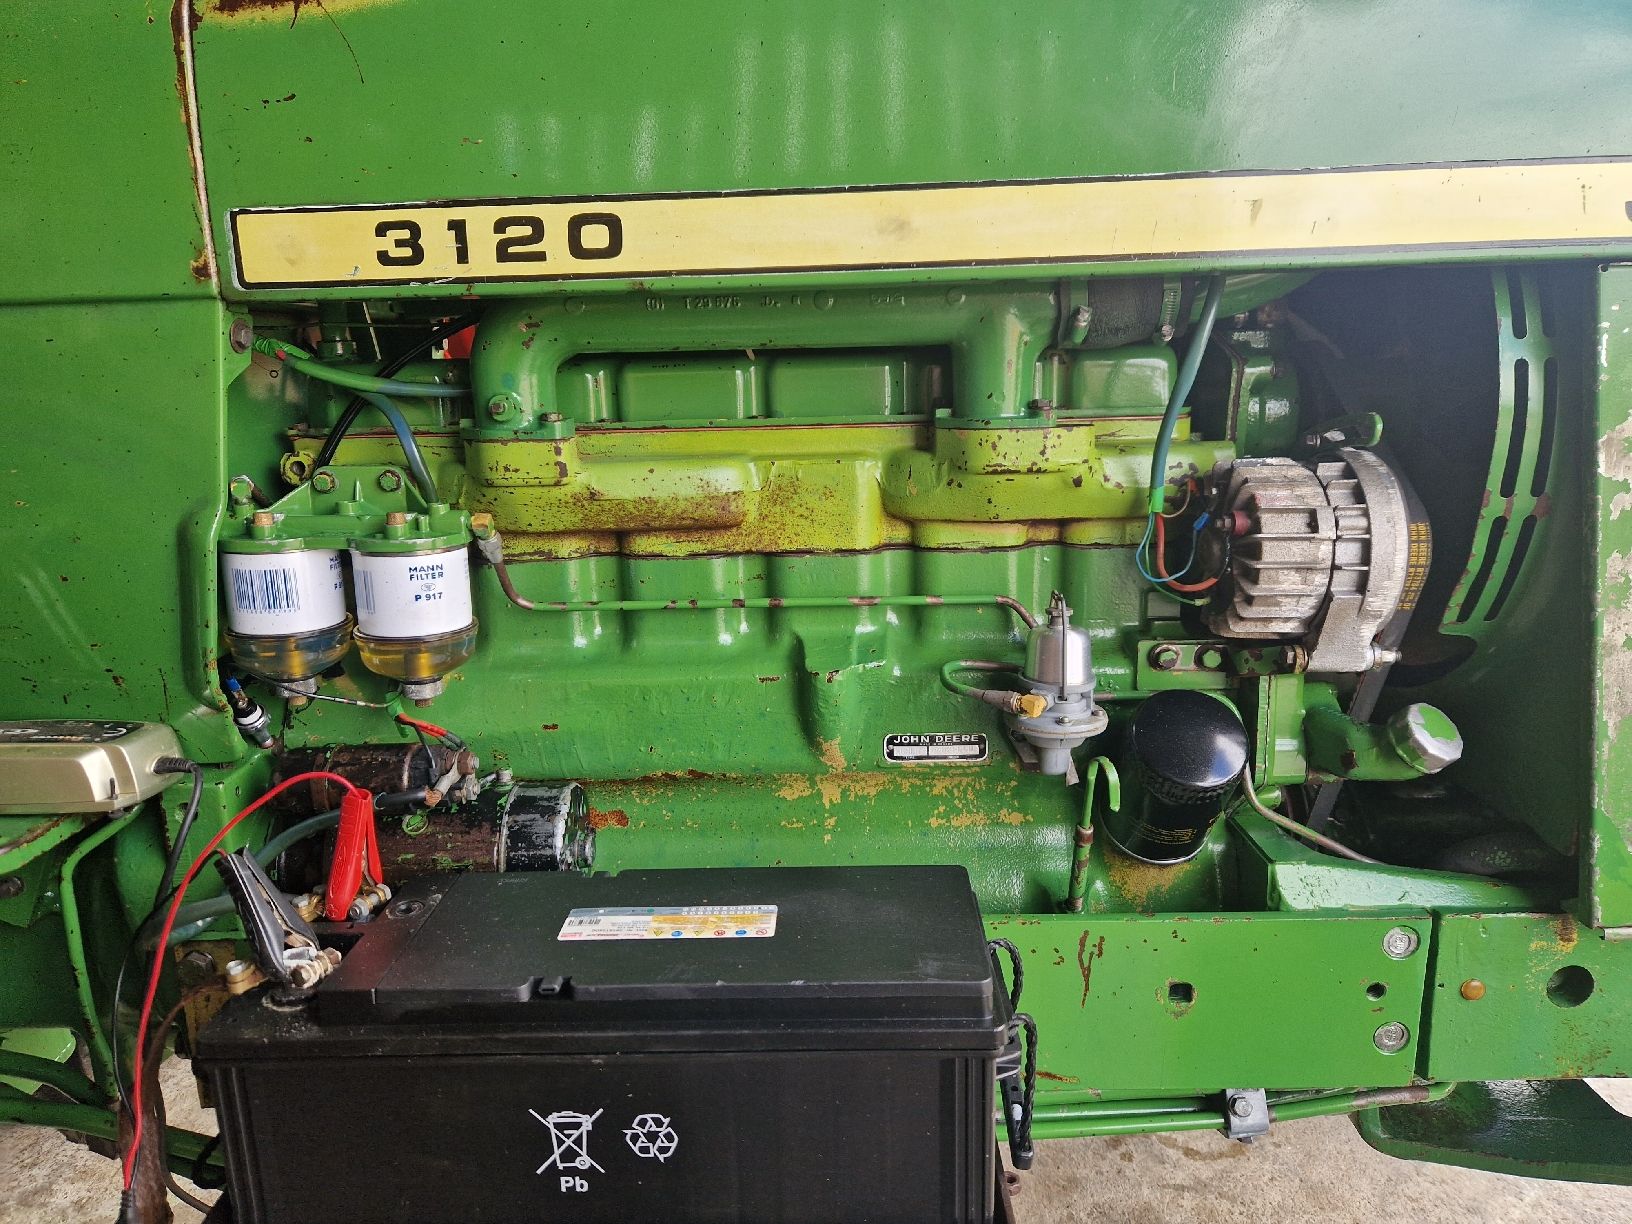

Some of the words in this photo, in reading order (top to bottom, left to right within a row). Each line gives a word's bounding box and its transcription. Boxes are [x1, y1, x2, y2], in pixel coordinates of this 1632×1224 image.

[375, 212, 623, 266] 3120
[408, 563, 444, 573] MANN
[409, 571, 444, 581] FILTER
[414, 593, 422, 602] P
[425, 592, 443, 601] 917
[893, 735, 930, 743] JOHN
[935, 734, 979, 743] DEERE
[560, 1176, 589, 1193] Pb
